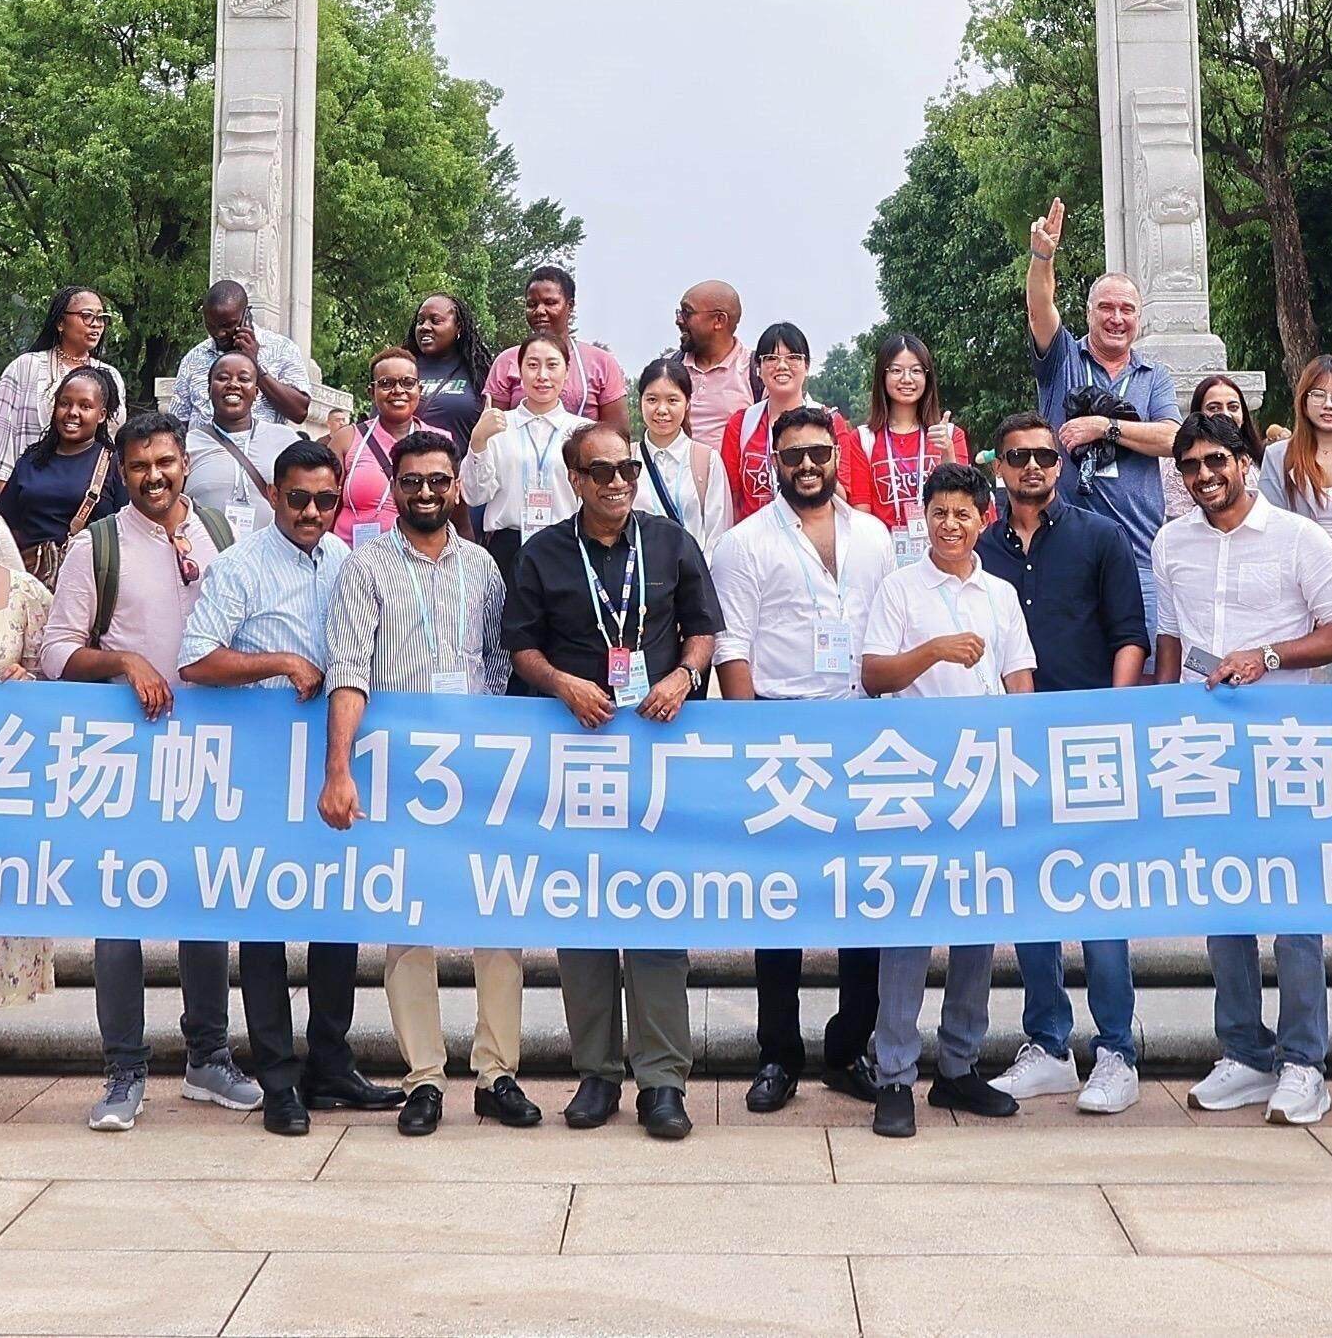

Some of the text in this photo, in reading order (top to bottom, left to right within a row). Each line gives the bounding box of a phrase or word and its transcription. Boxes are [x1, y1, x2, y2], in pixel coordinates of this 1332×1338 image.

[97, 849, 168, 910] to
[194, 846, 423, 926] World,
[468, 853, 798, 920] Welcome
[823, 850, 1015, 919] 137th
[1039, 848, 1299, 913] Canton
